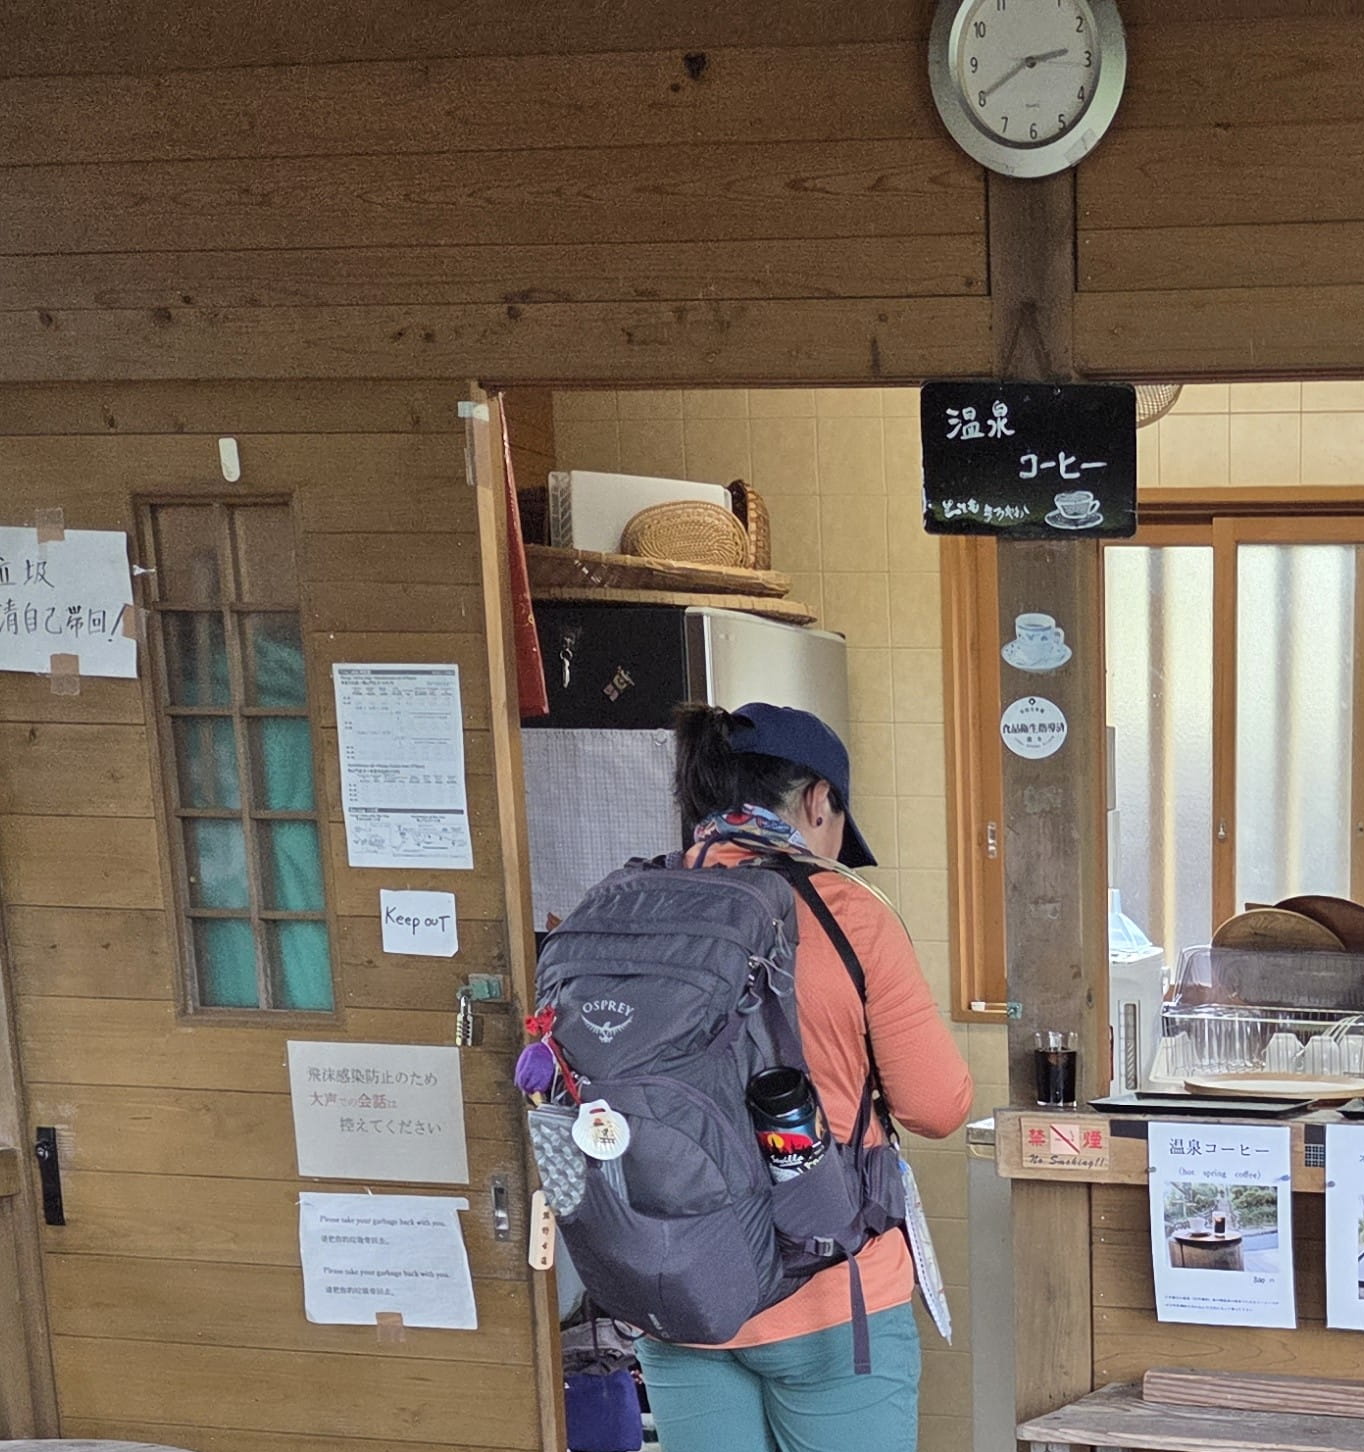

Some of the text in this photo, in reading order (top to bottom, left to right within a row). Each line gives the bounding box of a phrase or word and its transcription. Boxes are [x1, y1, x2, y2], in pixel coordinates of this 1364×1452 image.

[974, 21, 986, 38] 10
[1075, 16, 1084, 33] 2
[970, 57, 978, 73] 9
[1084, 50, 1092, 68] 3
[978, 91, 986, 107] 8
[1077, 86, 1085, 102] 4
[1001, 116, 1008, 133] 7
[1058, 114, 1066, 131] 5
[1029, 123, 1038, 140] 6
[946, 400, 1015, 439] 温泉
[1019, 451, 1107, 479] コーヒー
[385, 906, 420, 935] Keep
[582, 1000, 634, 1016] OSPREY
[307, 1067, 438, 1086] 飛沫感染防止のため
[340, 1117, 442, 1135] 控えてください
[1028, 1128, 1103, 1149] 禁 煙
[1169, 1138, 1270, 1156] 温泉コーヒー
[1030, 1154, 1043, 1164] No
[1203, 1169, 1226, 1178] spring
